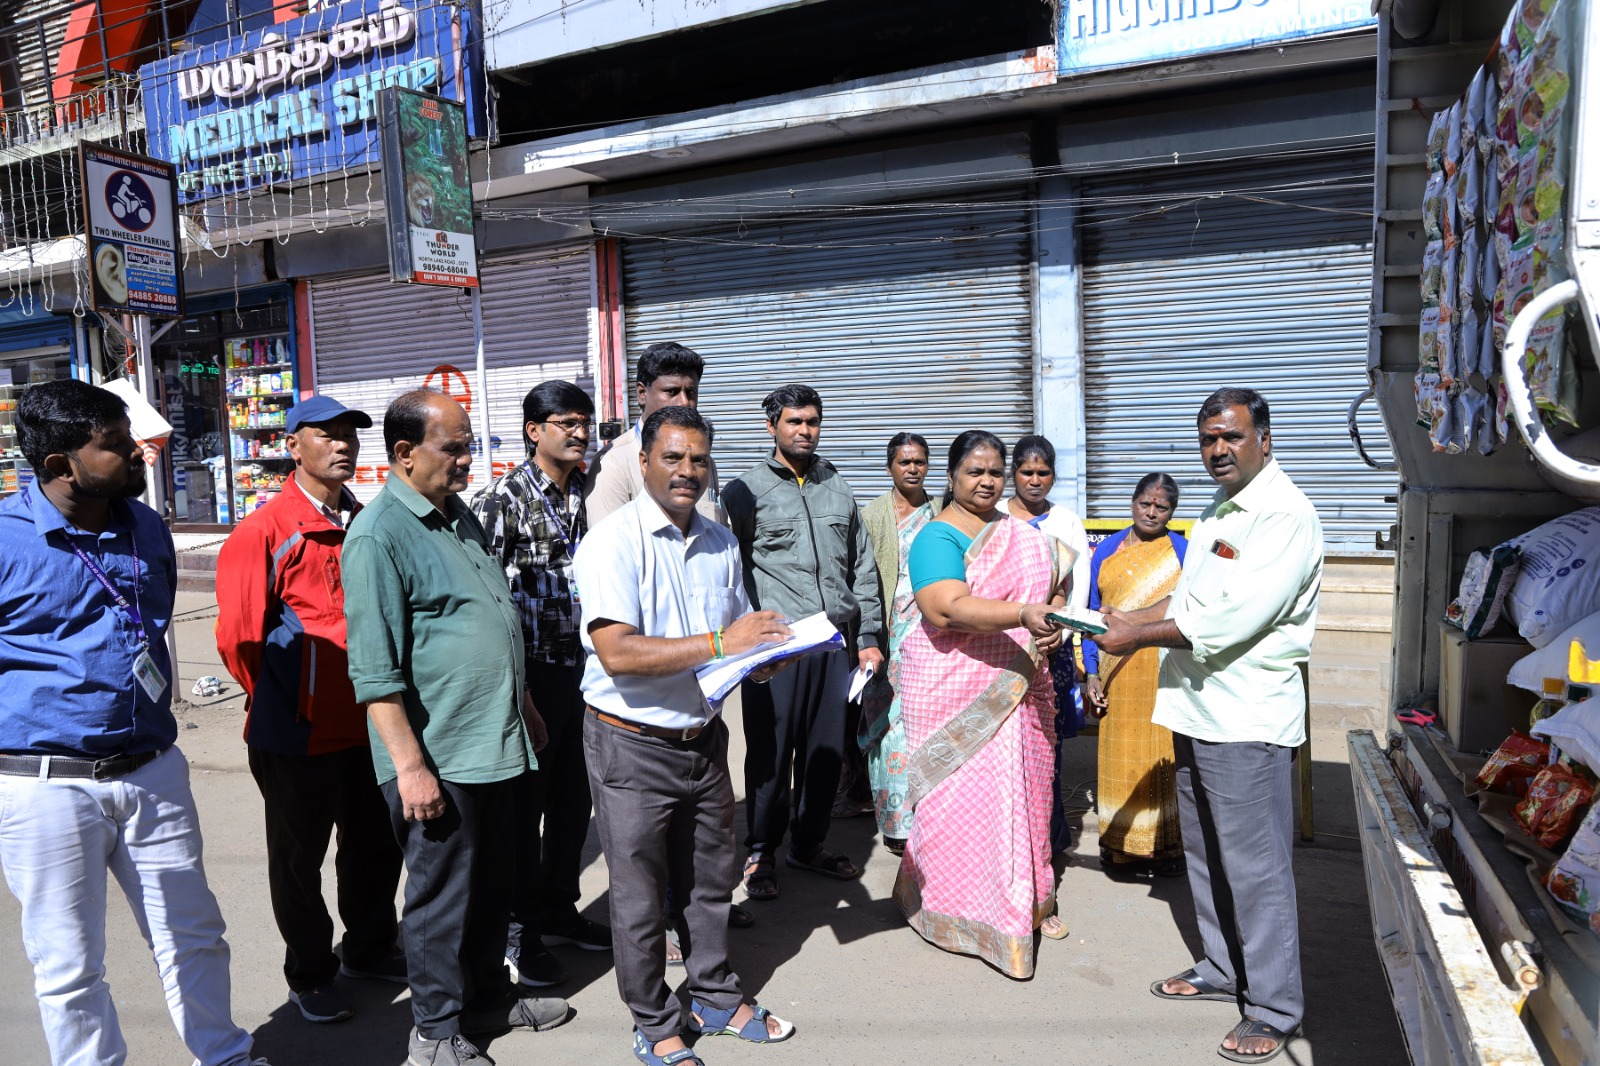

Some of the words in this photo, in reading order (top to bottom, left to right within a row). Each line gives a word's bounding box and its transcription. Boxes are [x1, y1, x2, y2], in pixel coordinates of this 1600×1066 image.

[1172, 4, 1362, 50] OOTACAMUND
[423, 98, 438, 110] RAIN
[419, 107, 443, 121] FOREST
[168, 89, 328, 164] MEDICAL
[115, 156, 132, 167] DISTRICT
[141, 163, 156, 173] TRAFFIC
[155, 167, 169, 176] POLICE
[94, 226, 110, 236] TWO
[111, 229, 142, 240] WHEELER
[143, 235, 170, 247] PARKING
[425, 240, 460, 251] THUNDER
[430, 249, 456, 258] WORLD
[422, 262, 468, 275] 98940-68048
[423, 273, 437, 281] DON'T
[437, 275, 451, 283] DRINK
[128, 290, 152, 301] 94885
[154, 293, 177, 305] 20888
[167, 386, 187, 487] milkymist
[97, 573, 118, 597] DEPARTMENT
